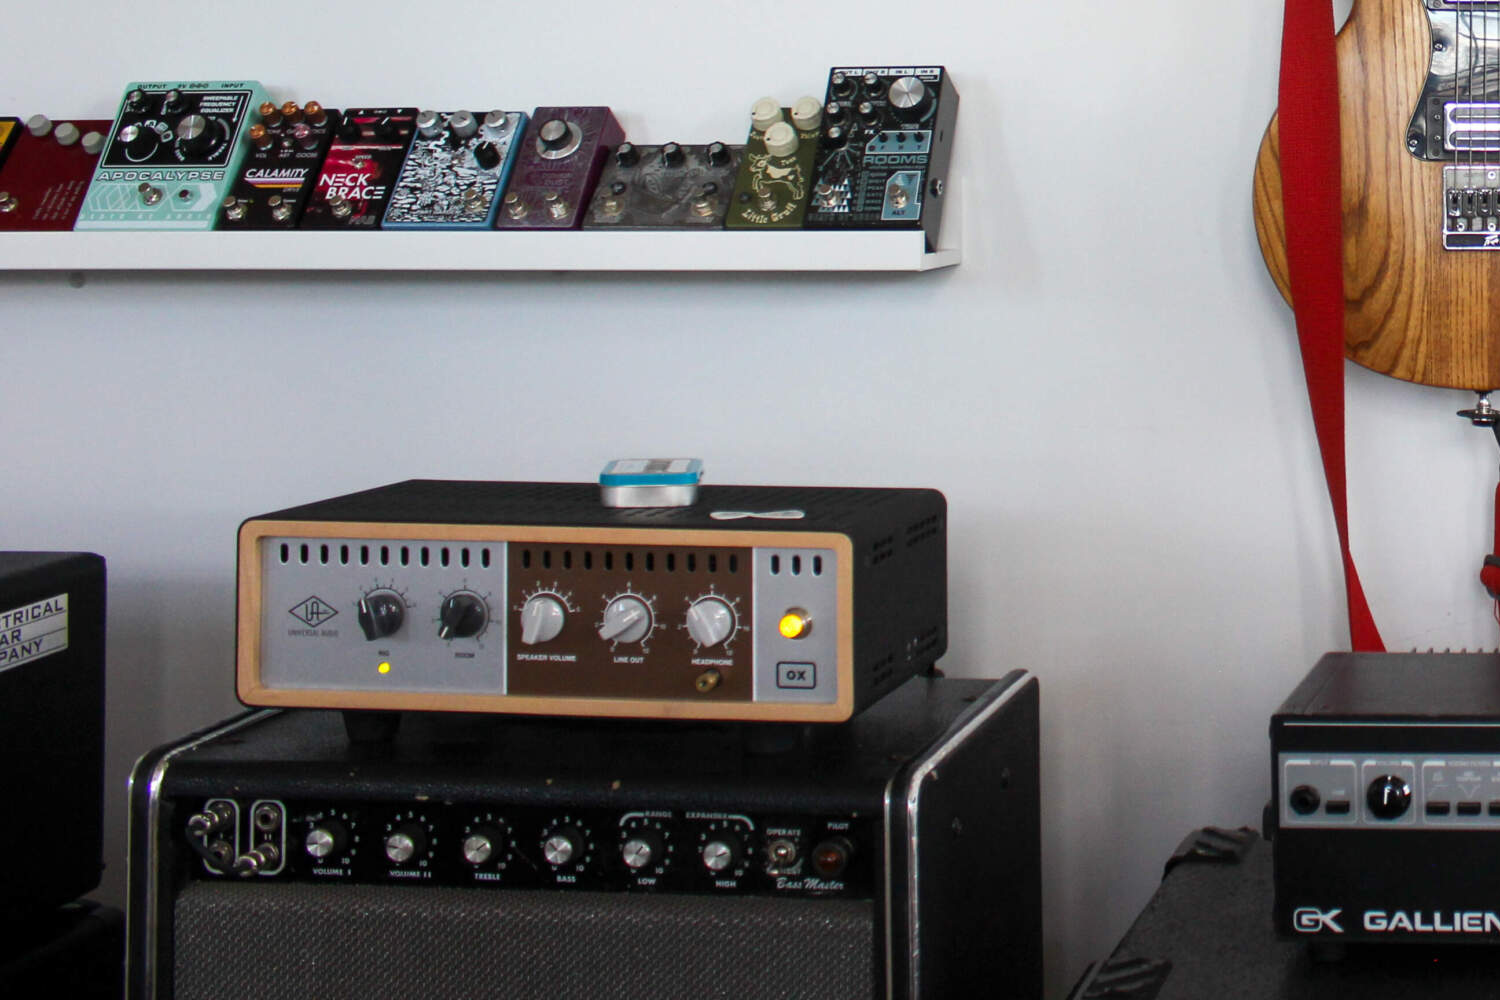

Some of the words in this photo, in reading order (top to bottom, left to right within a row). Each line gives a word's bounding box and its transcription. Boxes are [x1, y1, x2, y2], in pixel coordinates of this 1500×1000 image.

[863, 155, 928, 164] ROOMS
[96, 170, 226, 181] APOCALYPSE
[245, 168, 309, 178] CALAMITY
[319, 173, 372, 187] NECK
[325, 186, 386, 200] BRACE
[742, 208, 768, 224] Little
[0, 599, 64, 629] TRICAL
[516, 653, 547, 662] SPEAKER
[549, 654, 577, 662] VOLUME
[613, 656, 628, 664] LINE
[630, 656, 644, 664] OUT
[691, 658, 734, 667] HEADPHONE
[786, 670, 806, 682] OX
[766, 828, 801, 836] OPERATE
[312, 868, 343, 876] VOLUME
[556, 875, 576, 883] BASS
[715, 880, 736, 888] HIGH
[776, 877, 802, 889] Bass
[804, 878, 844, 890] Master
[1294, 908, 1344, 933] GK
